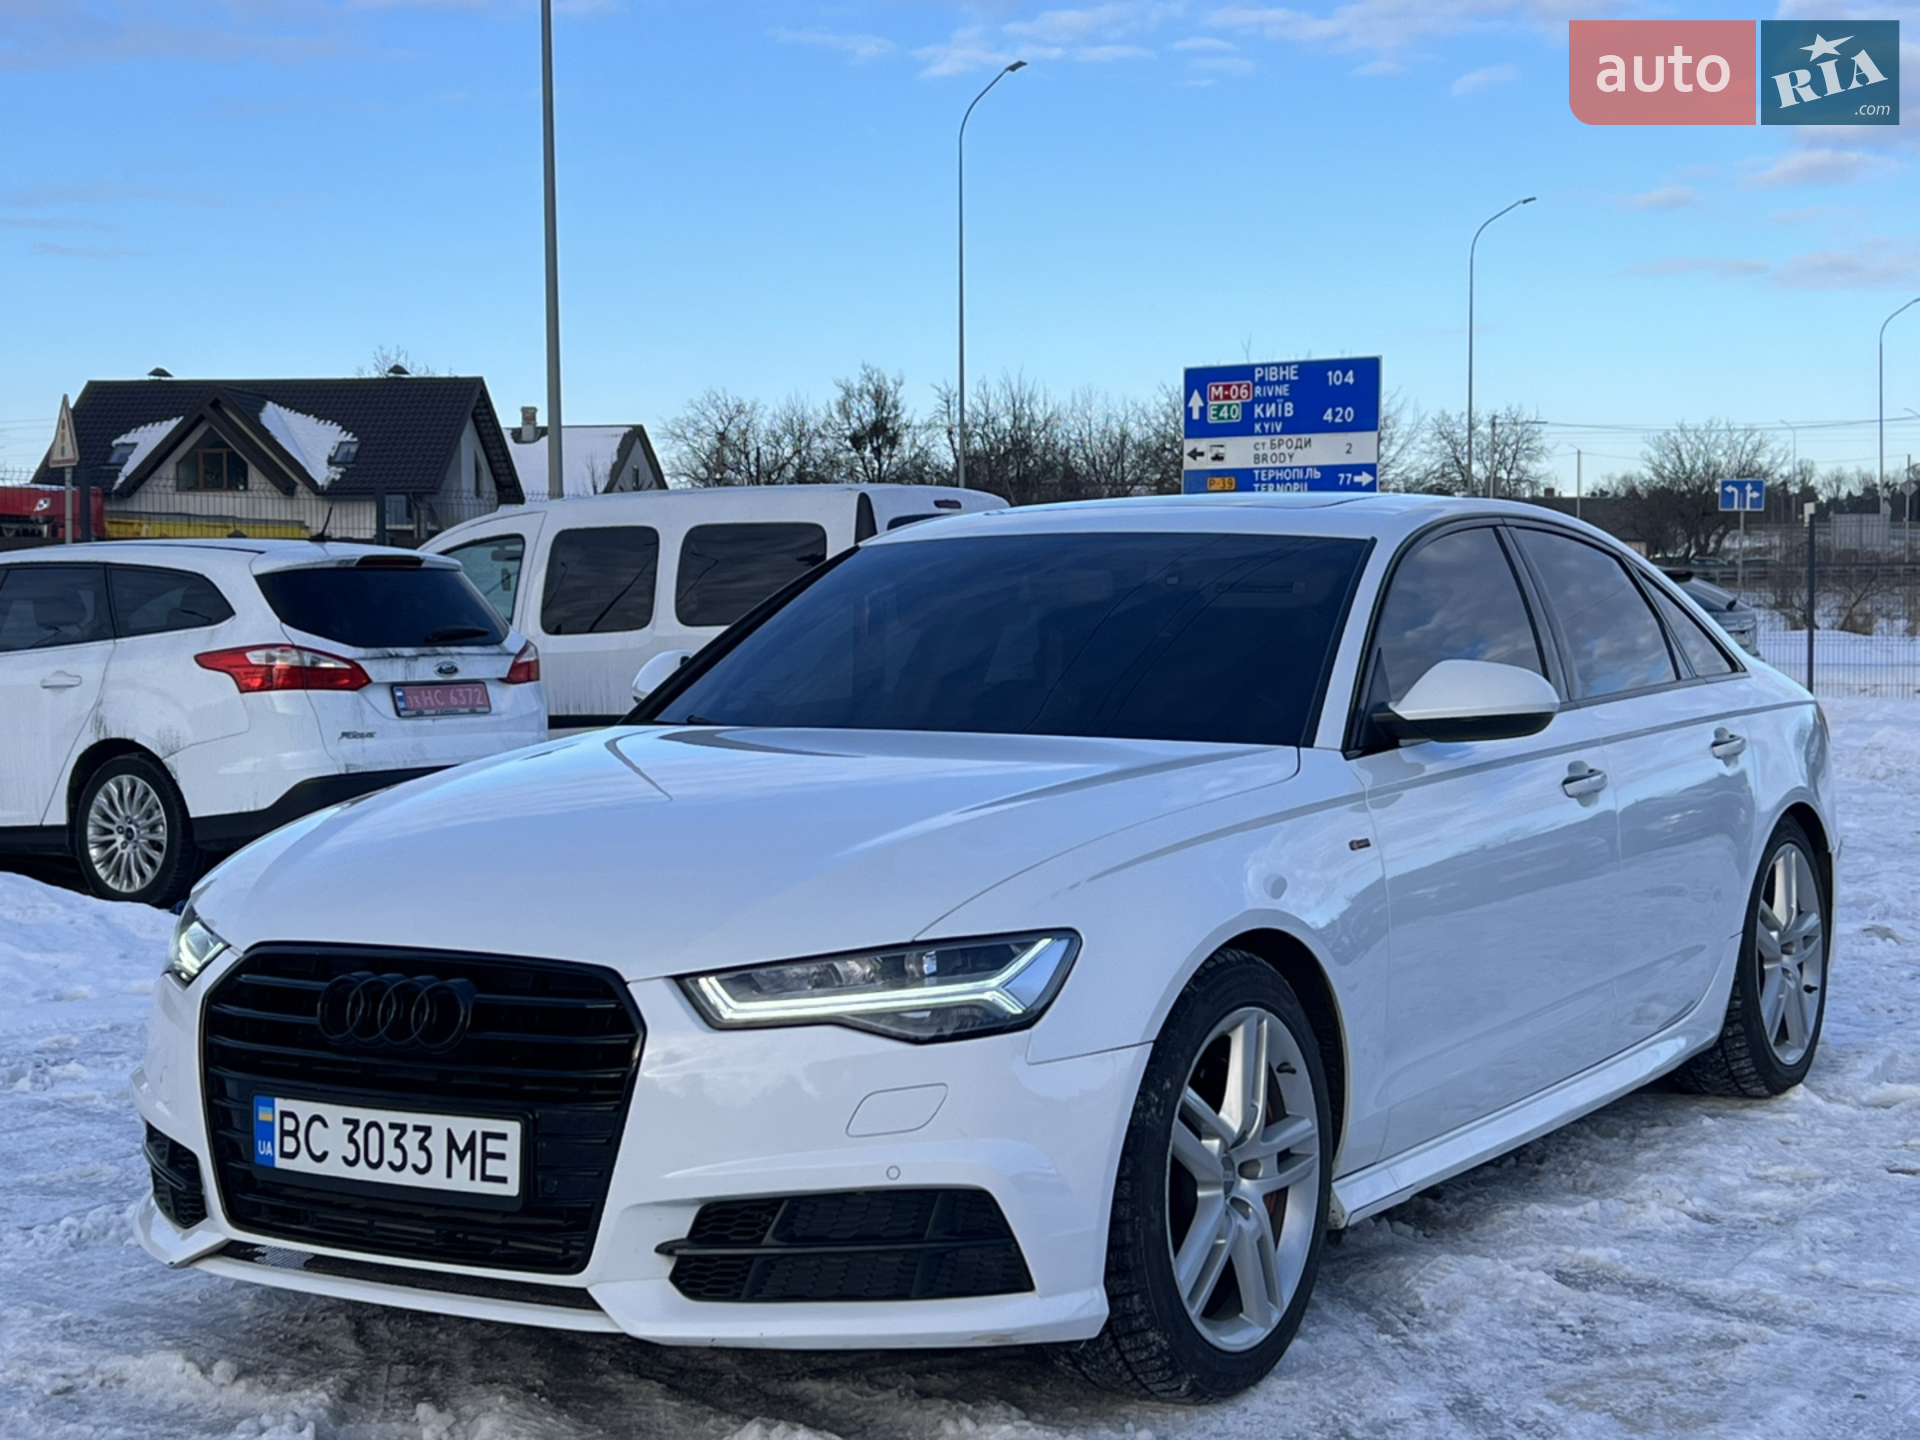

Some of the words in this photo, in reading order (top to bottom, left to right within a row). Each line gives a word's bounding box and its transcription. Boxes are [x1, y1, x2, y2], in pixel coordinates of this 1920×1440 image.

[1254, 364, 1299, 382] РІВНЕ
[1326, 369, 1355, 386] 104
[1254, 384, 1290, 397] RIVNE
[1210, 405, 1239, 420] E40
[1254, 399, 1294, 419] КИЇВ
[1322, 407, 1355, 423] 420
[1254, 422, 1283, 434] KYIV
[1345, 443, 1353, 455] 2
[1253, 452, 1295, 465] BRODY
[1253, 468, 1321, 481] ТЕРНОПІЛЬ
[1337, 473, 1353, 486] 77
[449, 687, 484, 706] 6372
[258, 1140, 274, 1157] UA
[279, 1109, 329, 1163] BC
[341, 1117, 433, 1175] 3033
[446, 1127, 508, 1184] ME
